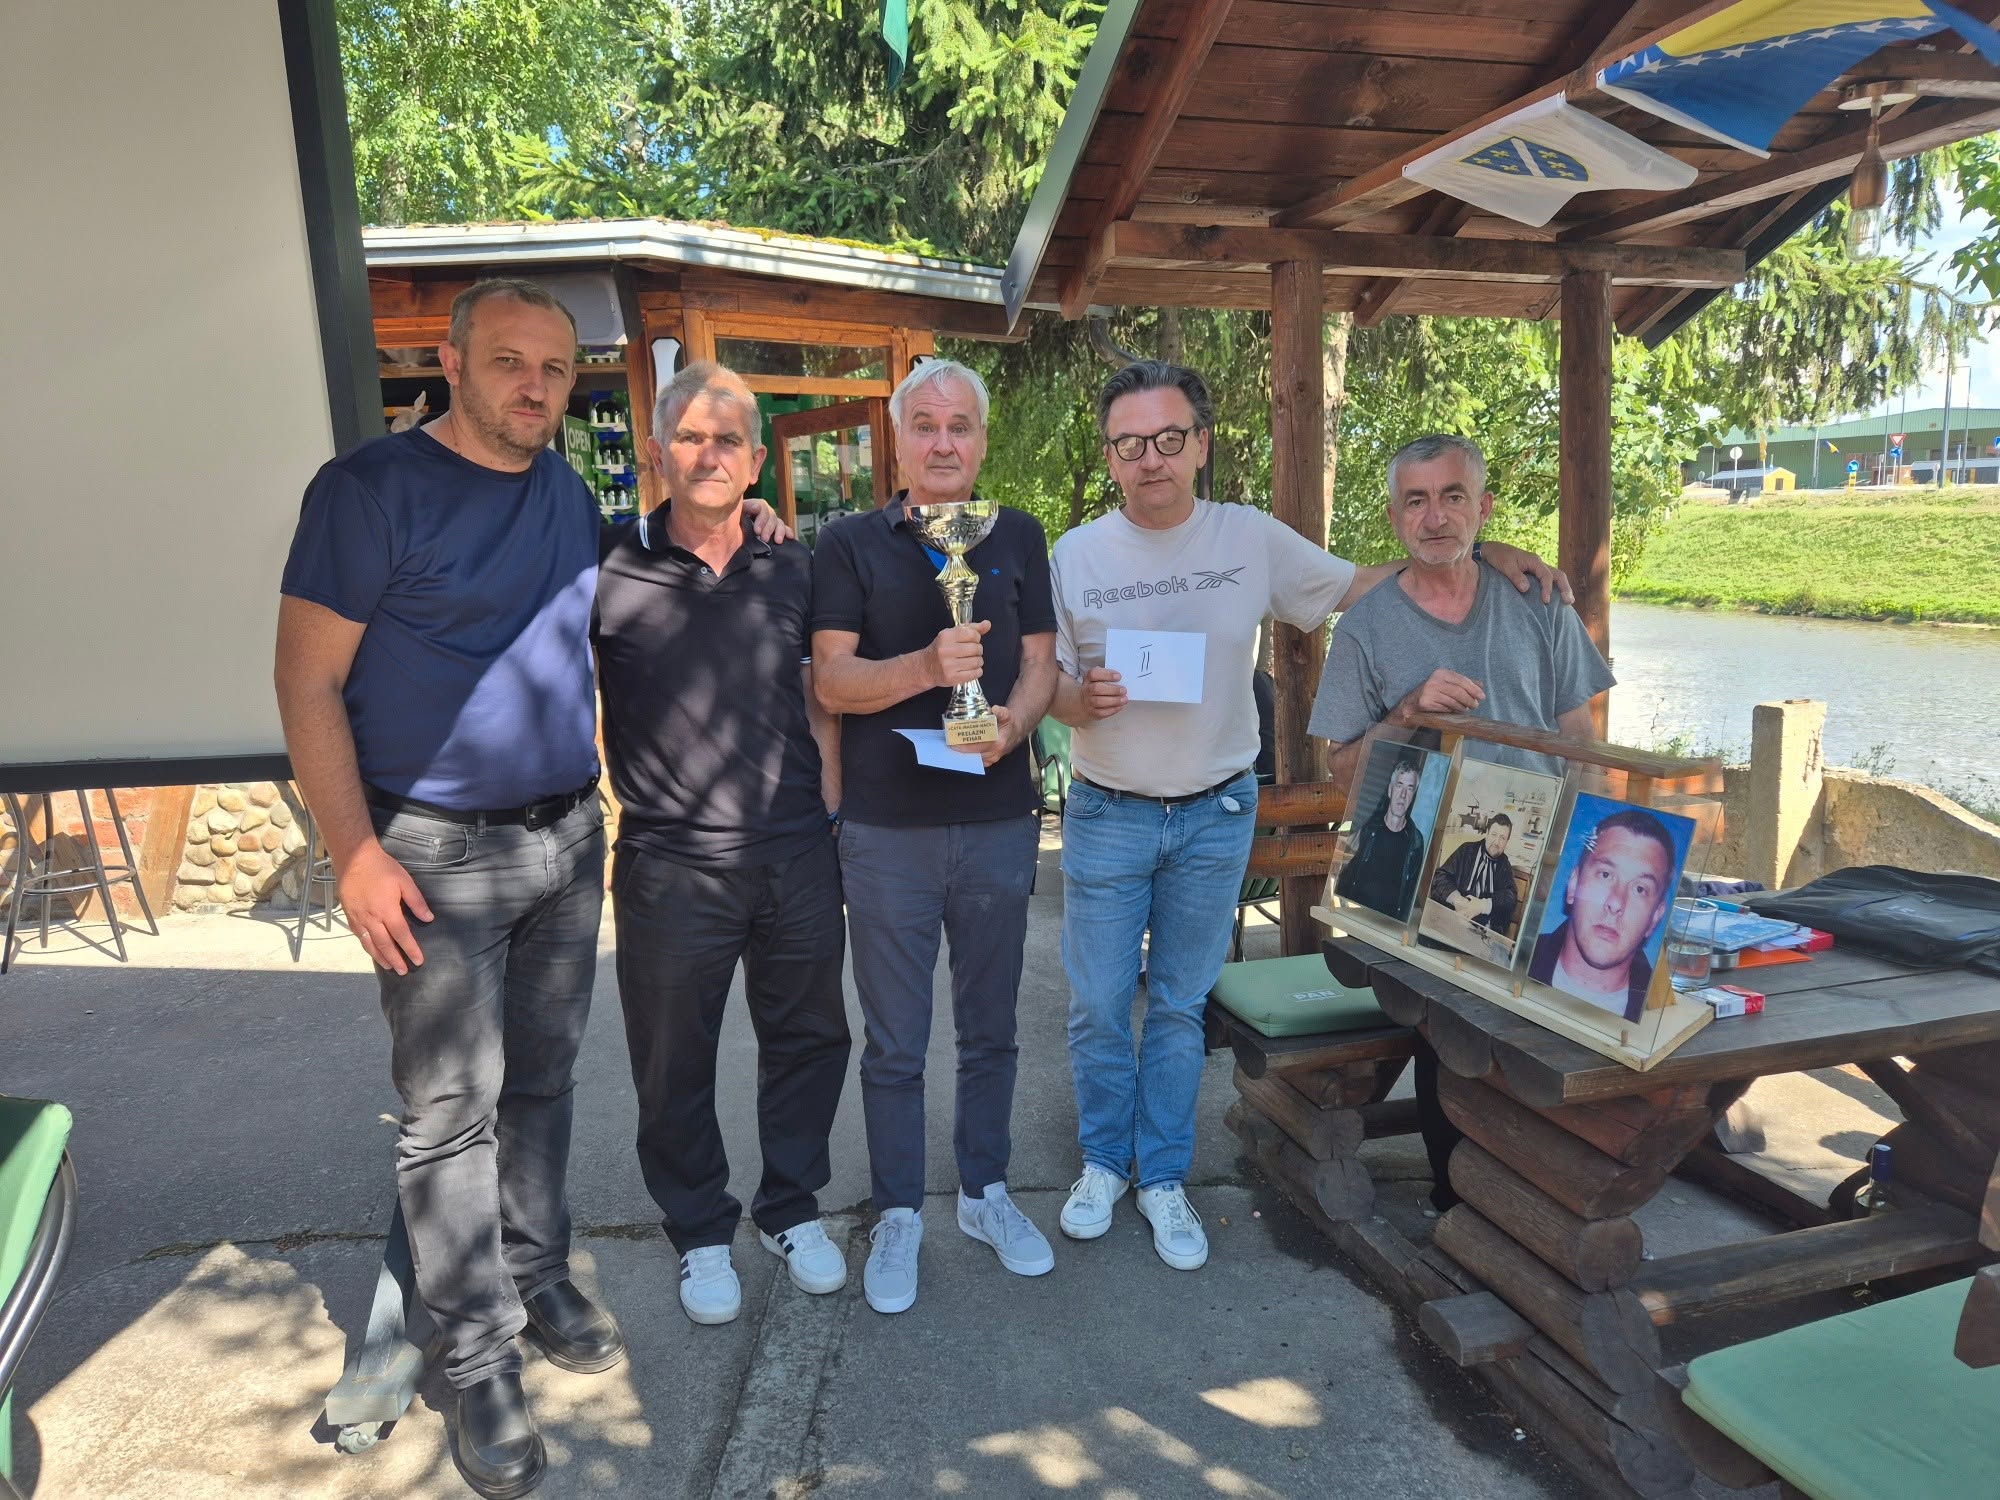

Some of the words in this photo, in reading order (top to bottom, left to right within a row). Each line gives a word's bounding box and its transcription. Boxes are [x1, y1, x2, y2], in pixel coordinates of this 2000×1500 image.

[568, 427, 591, 452] OPEN
[570, 453, 584, 475] TO
[1083, 576, 1189, 609] Reebok
